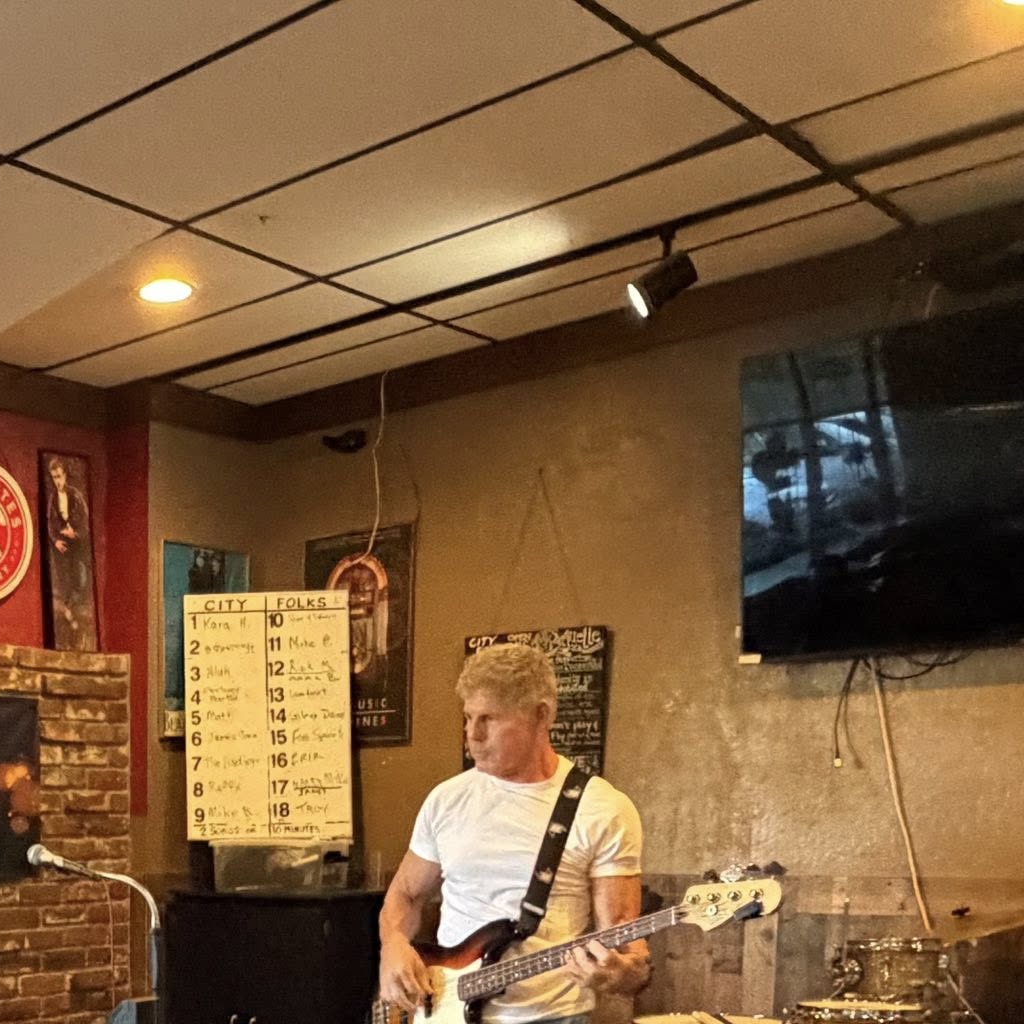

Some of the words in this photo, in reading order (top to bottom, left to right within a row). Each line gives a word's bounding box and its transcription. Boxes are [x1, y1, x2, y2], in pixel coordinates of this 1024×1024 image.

[204, 599, 248, 612] CITY
[277, 596, 327, 610] FOLKS
[191, 615, 198, 630] 1
[268, 612, 284, 628] 10
[189, 640, 200, 655] 2
[269, 636, 281, 651] 11
[190, 666, 201, 682] 3
[268, 661, 285, 677] 12
[190, 690, 201, 705] 4
[269, 687, 285, 703] 13
[358, 697, 387, 710] USIC
[191, 710, 201, 726] 5
[270, 708, 287, 723] 14
[191, 731, 202, 747] 6
[270, 729, 287, 745] 15
[191, 756, 202, 771] 7
[272, 752, 288, 768] 16
[193, 782, 204, 798] 8
[272, 780, 289, 795] 17
[194, 808, 205, 823] 9
[273, 802, 290, 818] 18
